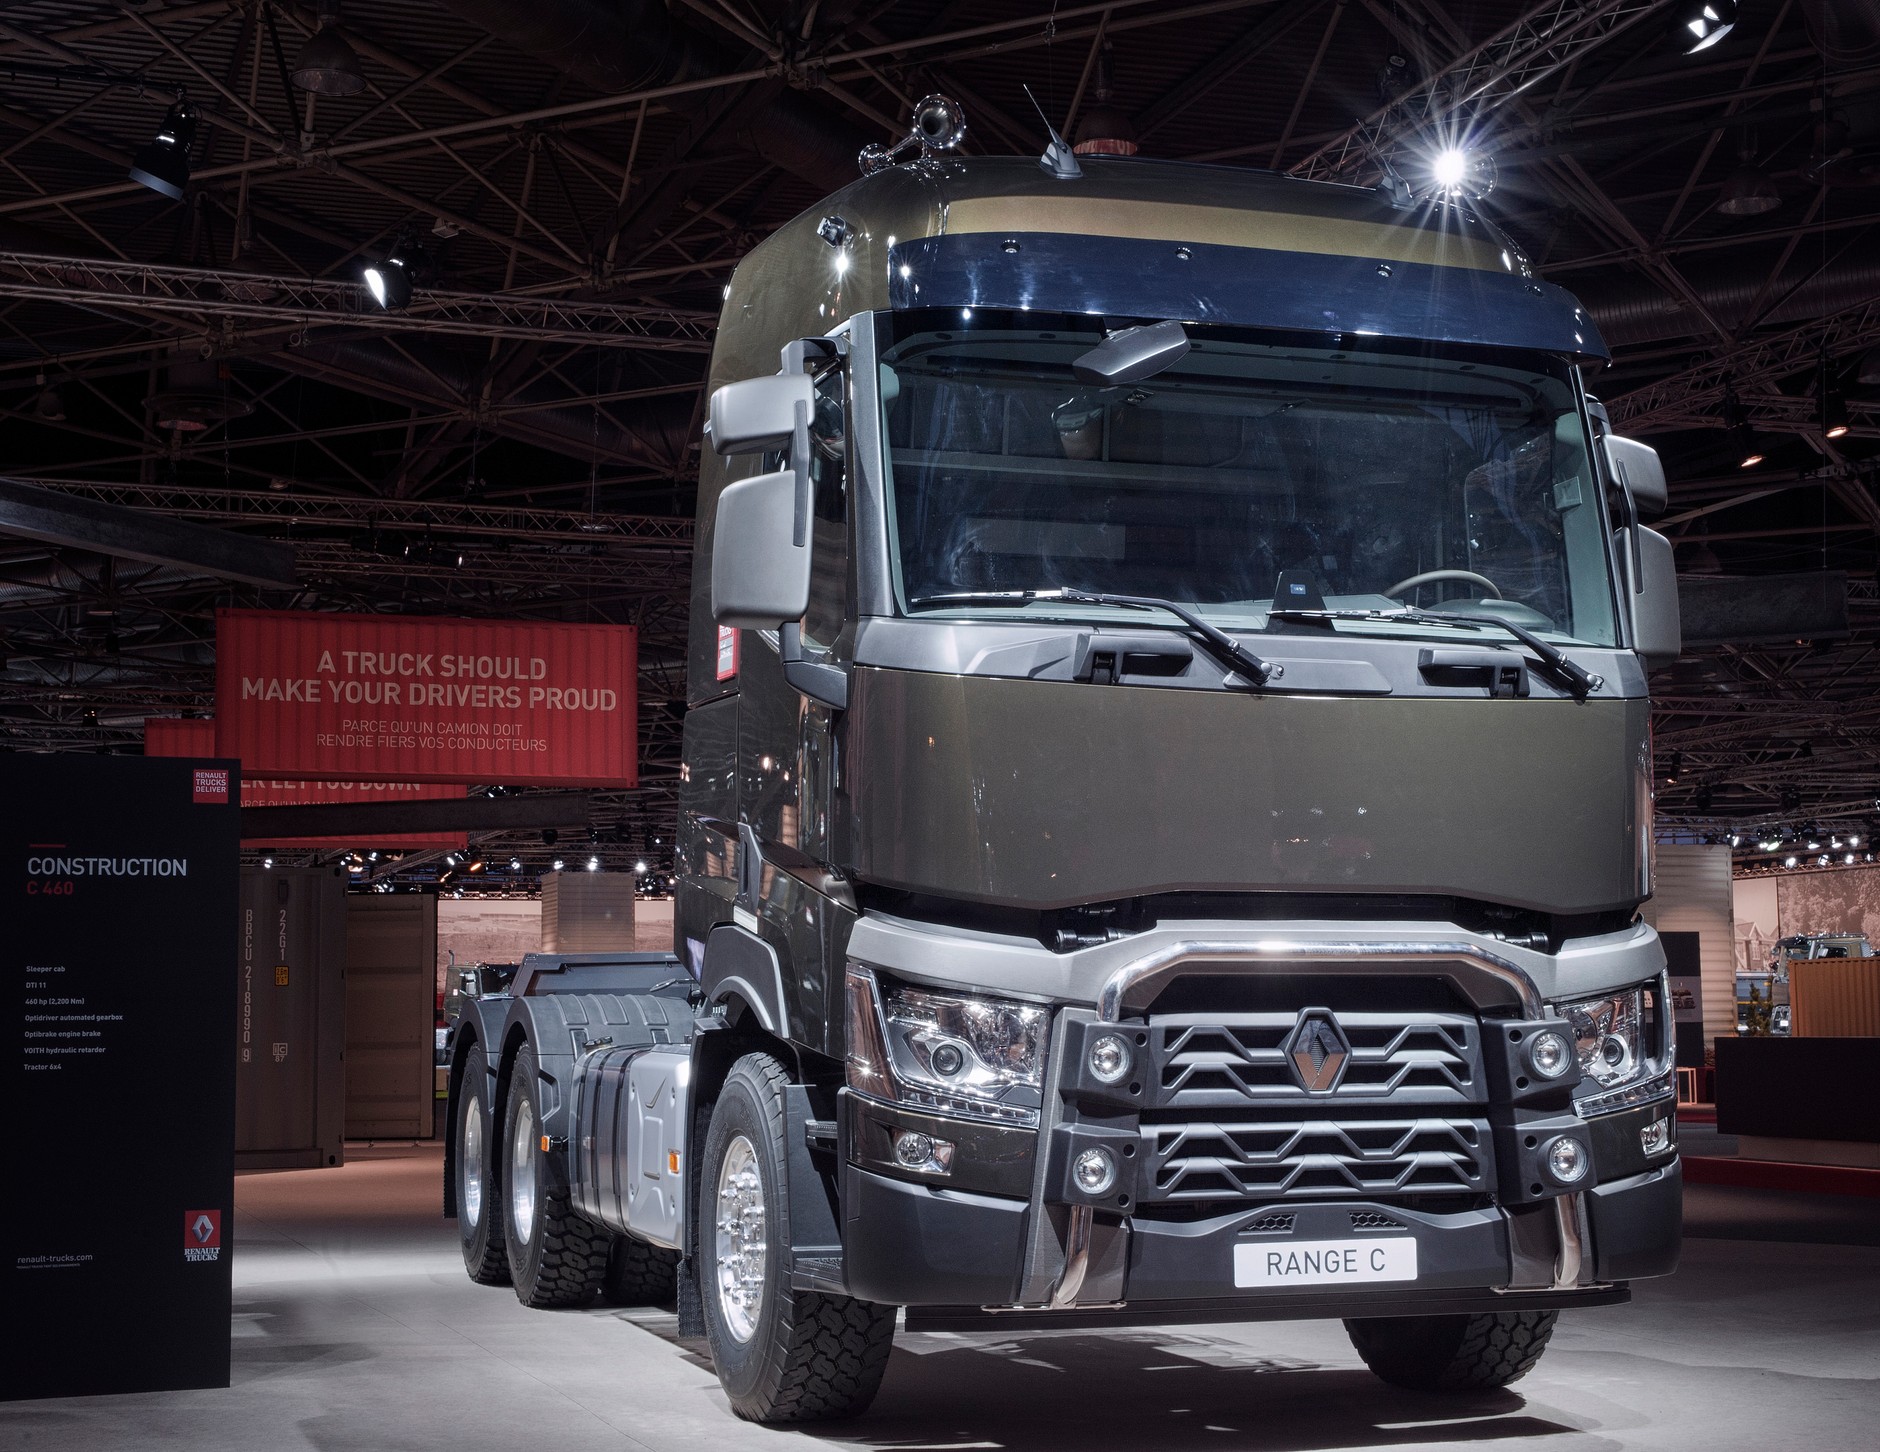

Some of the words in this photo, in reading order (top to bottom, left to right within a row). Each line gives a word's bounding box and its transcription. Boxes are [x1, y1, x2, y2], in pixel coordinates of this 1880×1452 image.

[316, 650, 336, 673] A
[342, 651, 434, 677] TRUCK
[439, 654, 547, 680] SHOULD
[242, 677, 322, 704] MAKE
[328, 680, 402, 705] YOUR
[408, 683, 522, 709] DRIVERS
[528, 686, 617, 711] PROUD
[342, 719, 388, 734] PARCE
[390, 720, 434, 735] QU'UN
[436, 721, 489, 736] CAMION
[493, 722, 523, 737] DOIT
[316, 733, 374, 748] RENDRE
[377, 735, 416, 749] FIERS
[419, 736, 444, 750] VOS
[448, 737, 547, 752] CONDUCTEURS
[195, 771, 227, 779] RENAULT
[27, 857, 188, 877] CONSTRUCTION
[26, 881, 39, 896] C
[42, 880, 74, 896] 460
[245, 909, 253, 961] BBCU
[279, 909, 287, 961] 22G1
[25, 965, 53, 974] Sleeper
[53, 965, 66, 973] cab
[25, 981, 37, 989] DTI
[38, 981, 47, 989] 11
[38, 997, 48, 1006] hp
[48, 997, 70, 1006] (2,200
[70, 997, 85, 1005] Nm)
[24, 1014, 58, 1022] Optidriver
[59, 1013, 95, 1021] automated
[96, 1013, 123, 1022] gearbox
[24, 1030, 57, 1038] Optibrake
[58, 1030, 81, 1038] engine
[81, 1029, 101, 1037] brake
[24, 1046, 45, 1054] VOITH
[45, 1046, 77, 1055] hydraulic
[78, 1046, 106, 1054] retarder
[243, 1048, 250, 1062] 9
[24, 1063, 48, 1071] Tractor
[49, 1063, 62, 1071] 6x4
[183, 1247, 220, 1256] RENAULT
[17, 1253, 93, 1264] renault-trucks.com
[185, 1254, 218, 1262] TRUCKS
[1267, 1249, 1358, 1276] RANGE
[1370, 1248, 1386, 1272] C
